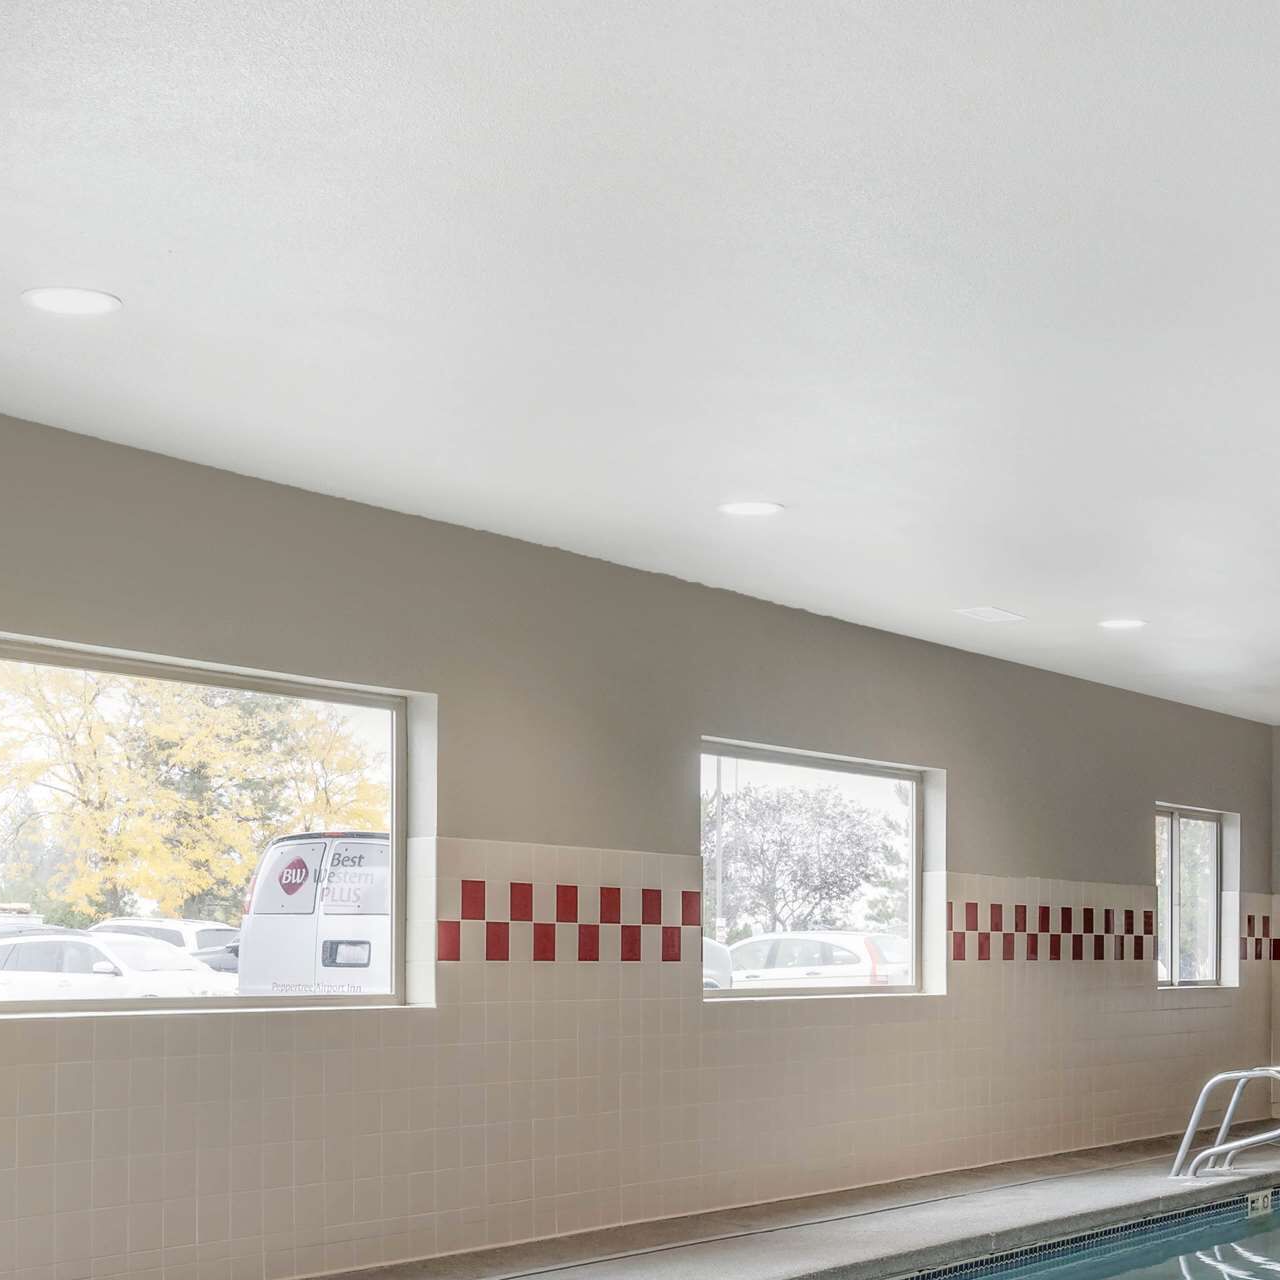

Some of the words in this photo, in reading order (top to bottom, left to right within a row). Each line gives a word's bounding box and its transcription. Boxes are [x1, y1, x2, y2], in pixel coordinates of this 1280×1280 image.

[330, 852, 364, 868] Best
[282, 868, 306, 884] BW
[313, 868, 374, 884] Western
[320, 886, 360, 903] PLUS
[347, 983, 362, 993] Inn
